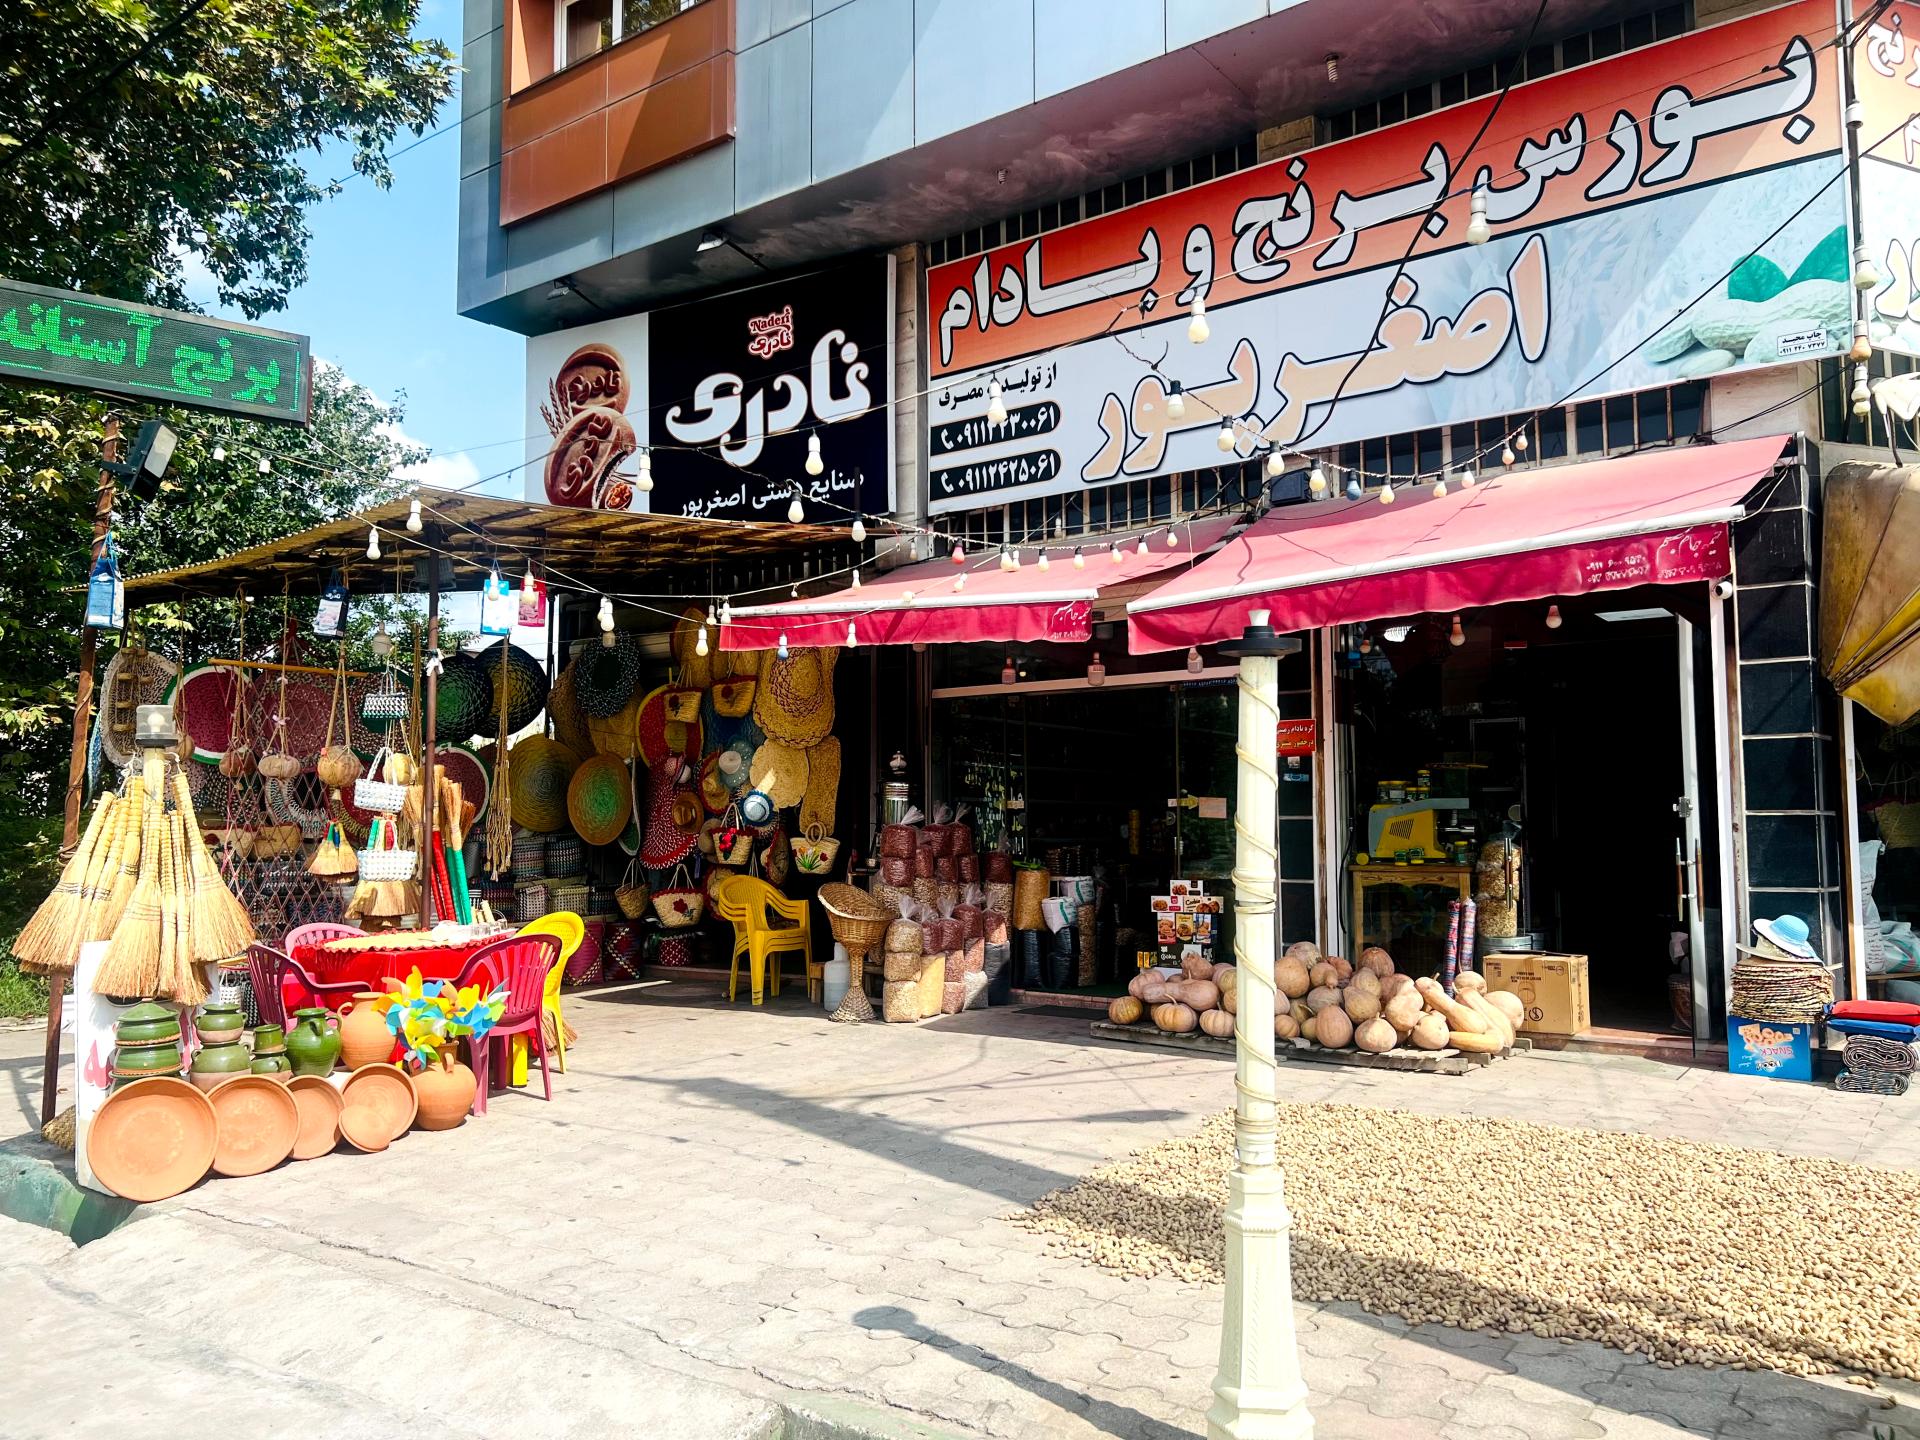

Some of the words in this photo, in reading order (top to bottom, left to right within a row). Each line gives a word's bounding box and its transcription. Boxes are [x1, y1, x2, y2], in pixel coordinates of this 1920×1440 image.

[1474, 35, 1817, 224] بورس
[1231, 141, 1452, 285] برنج
[938, 226, 1161, 368] بادام
[1174, 224, 1215, 307] و
[749, 307, 791, 332] Naderi
[749, 328, 792, 357] نادری
[171, 337, 281, 405] برنج
[1000, 366, 1042, 393] تولید
[1044, 361, 1057, 389] از
[1081, 232, 1552, 483] اصغرپور
[665, 329, 872, 468] نادری
[938, 386, 984, 410] مصرف
[957, 451, 1056, 492] ۰۹۱۱۲۴۲۵۰۶۱
